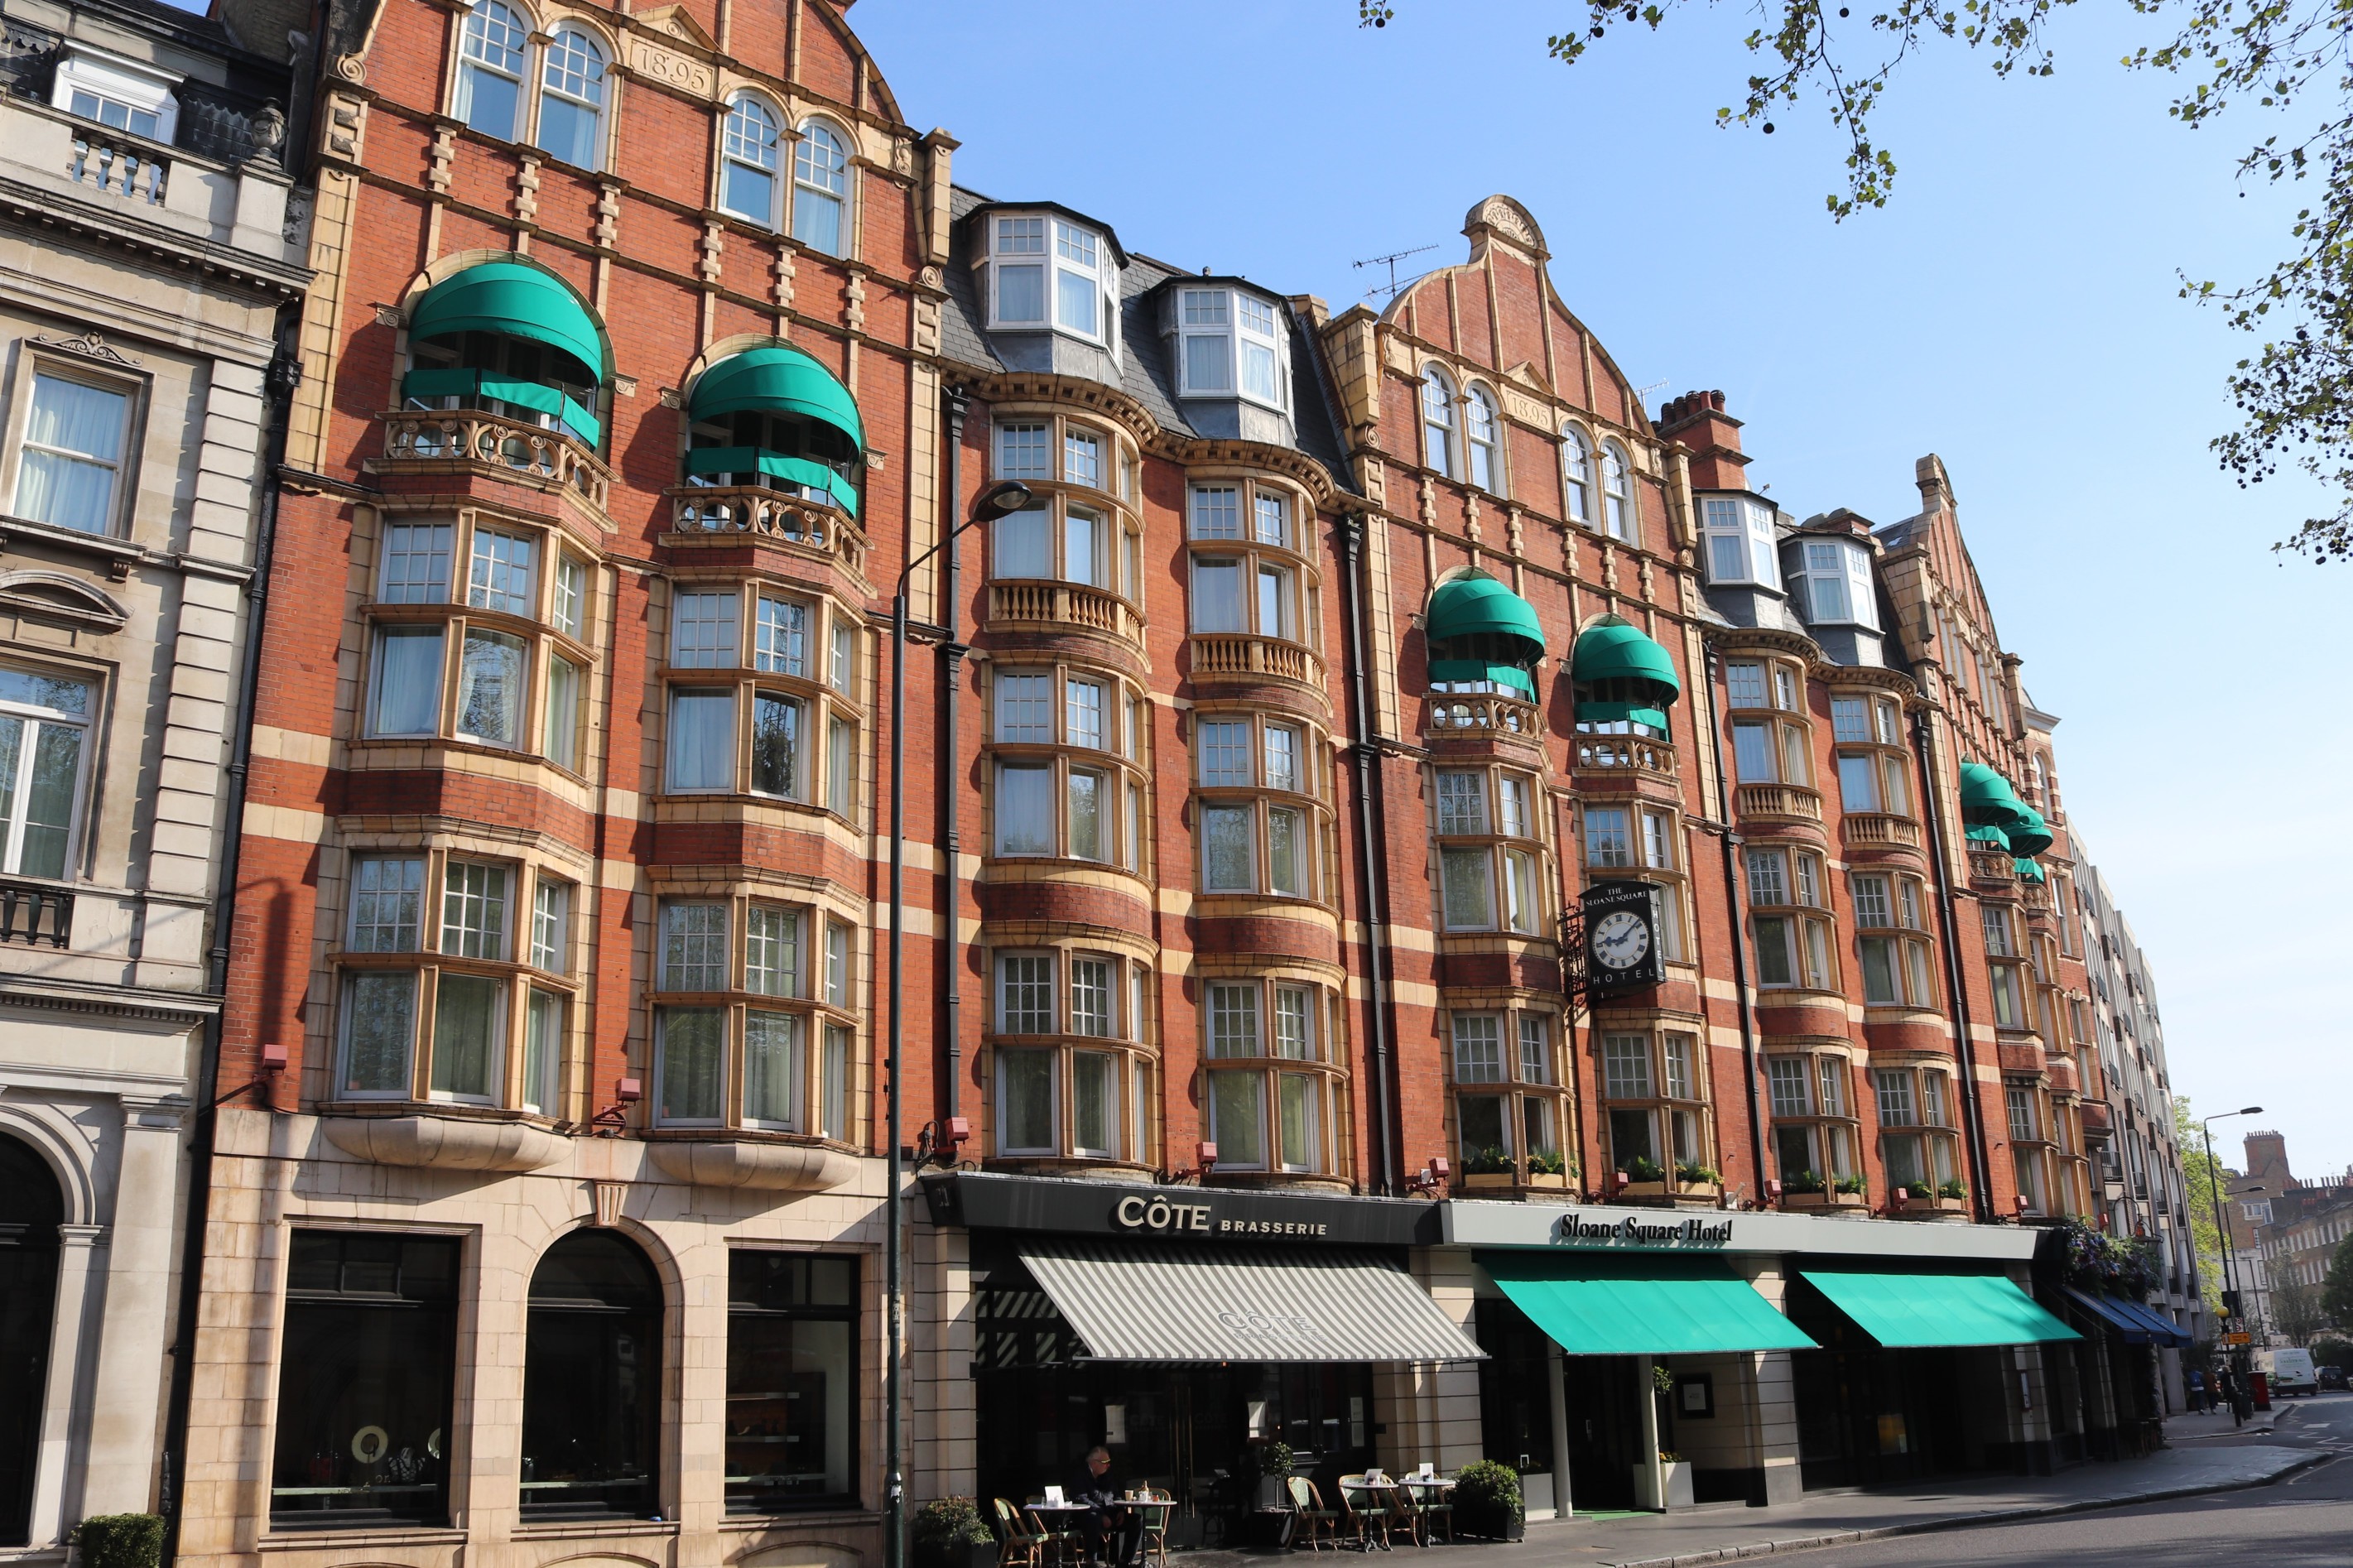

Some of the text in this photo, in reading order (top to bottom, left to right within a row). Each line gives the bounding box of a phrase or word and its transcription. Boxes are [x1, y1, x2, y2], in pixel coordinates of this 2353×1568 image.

[1586, 891, 1648, 907] SLOANE SQUARE
[1607, 887, 1623, 896] THE
[1653, 909, 1663, 973] HOTEL
[1593, 968, 1654, 985] HOTEL
[1118, 1194, 1327, 1235] CÔTE BRASSERIE
[1560, 1213, 1734, 1244] Sloane Square Hotel
